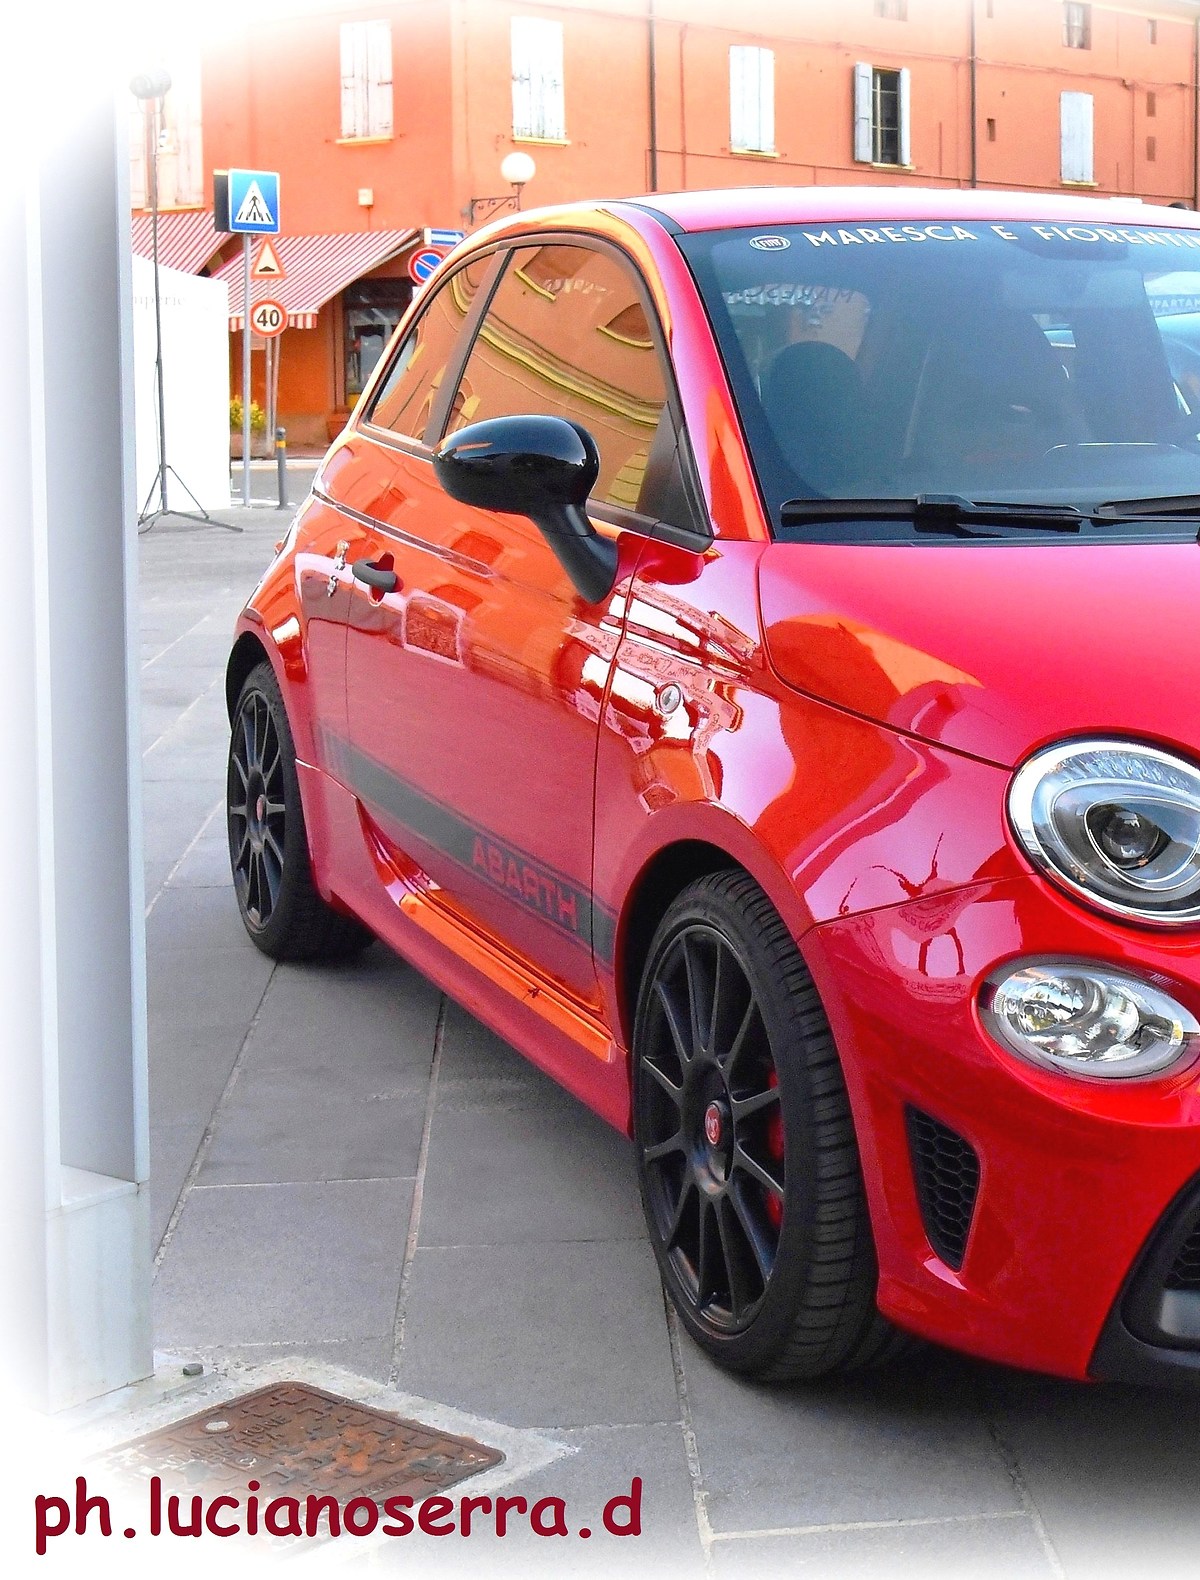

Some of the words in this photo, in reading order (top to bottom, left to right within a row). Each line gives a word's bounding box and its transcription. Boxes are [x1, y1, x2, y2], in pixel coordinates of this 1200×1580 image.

[802, 225, 979, 248] MARESCA
[990, 225, 1018, 240] E
[256, 309, 280, 327] 40
[472, 834, 578, 932] ABARTH
